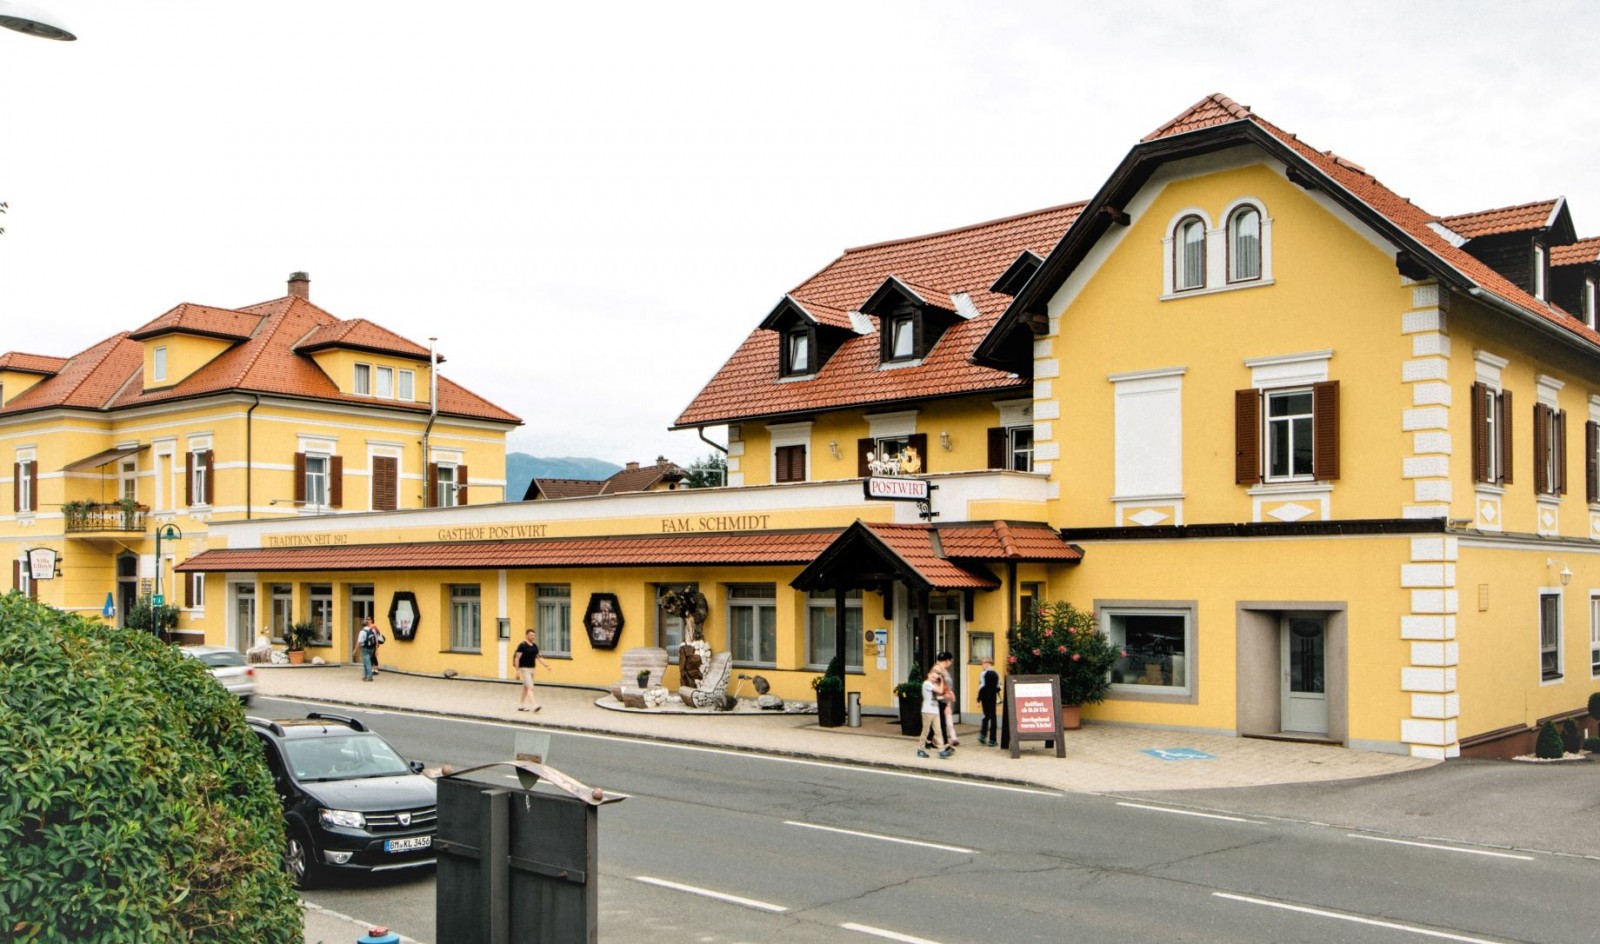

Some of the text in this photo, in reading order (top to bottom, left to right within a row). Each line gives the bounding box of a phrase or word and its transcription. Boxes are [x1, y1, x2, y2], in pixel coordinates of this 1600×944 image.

[872, 480, 925, 495] POSTWIRT
[661, 514, 770, 532] FAM. SCHMIDT
[268, 533, 347, 547] TRADITION SEIT 1912
[438, 524, 548, 541] GASTHOF POSTWIRT
[403, 839, 412, 848] KL
[413, 837, 430, 847] 3456
